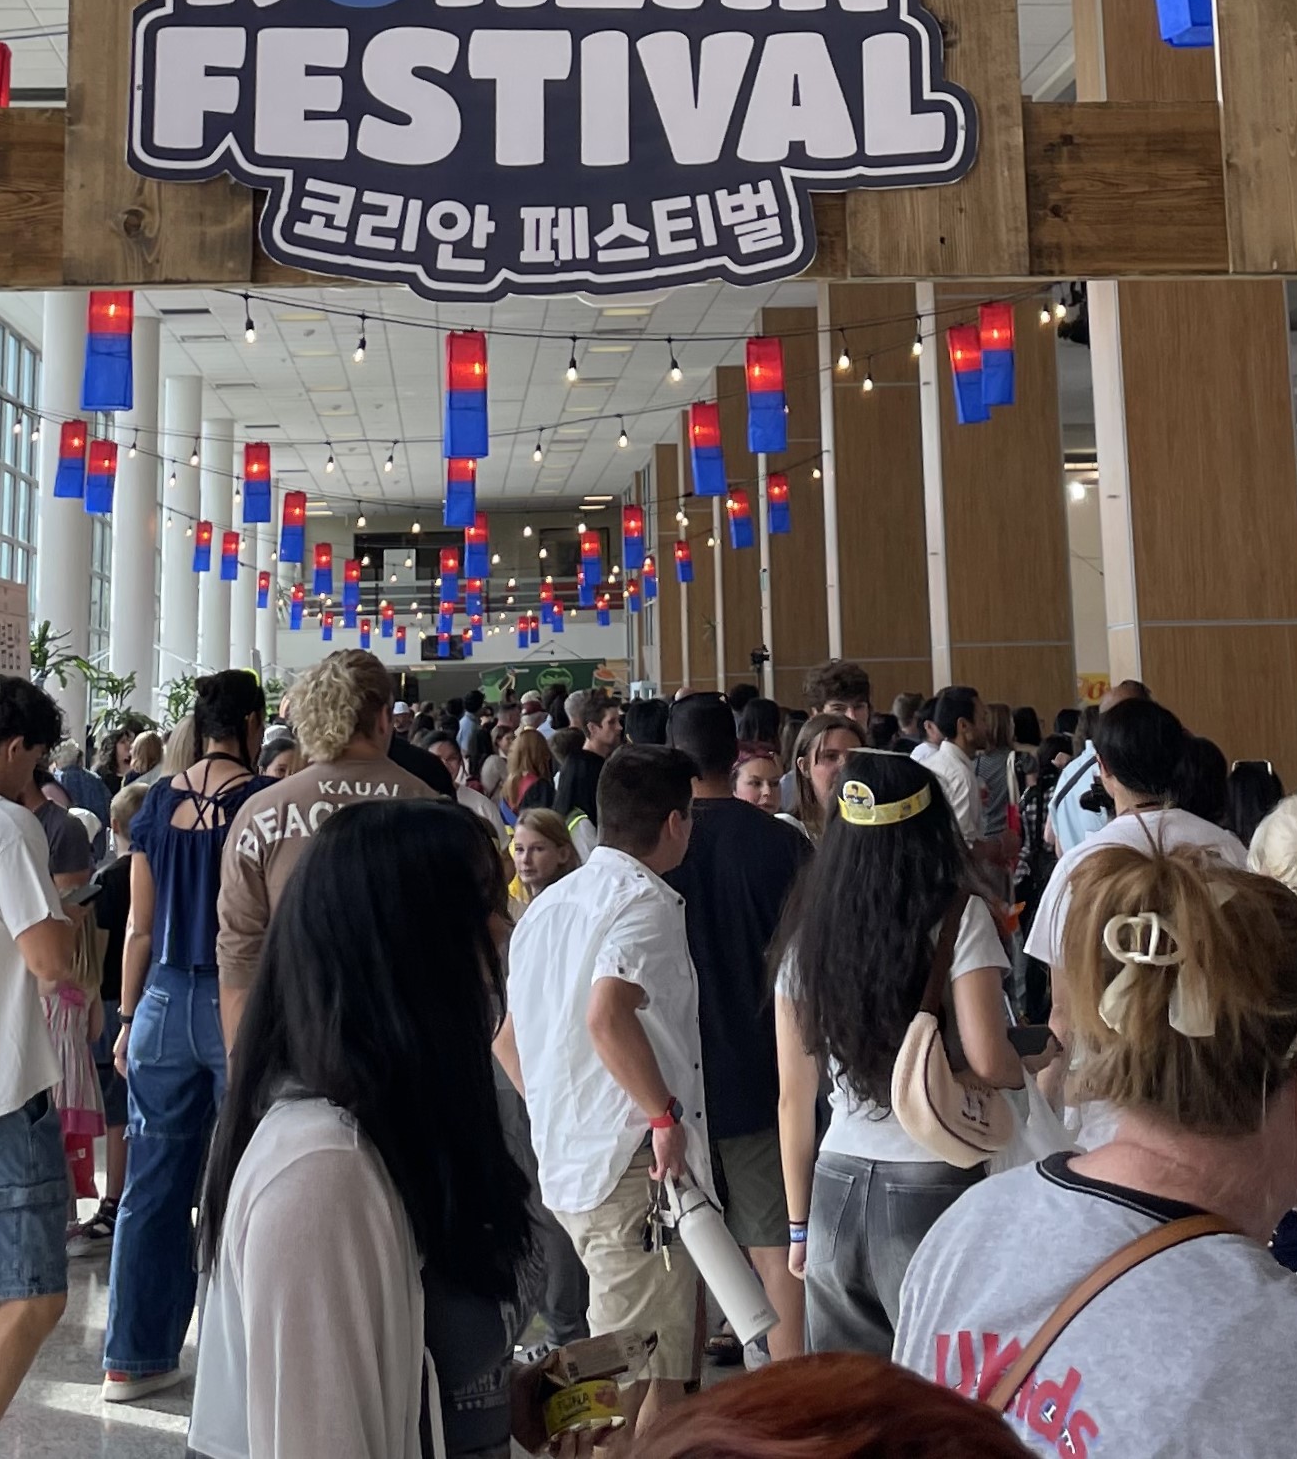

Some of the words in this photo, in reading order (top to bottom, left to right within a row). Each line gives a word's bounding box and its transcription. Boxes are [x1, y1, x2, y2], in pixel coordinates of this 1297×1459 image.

[153, 26, 946, 167] FESTIVAL
[292, 178, 496, 272] 코리안
[518, 178, 782, 263] 페스티벌
[318, 780, 400, 797] KAUAI
[235, 801, 344, 862] BEAC
